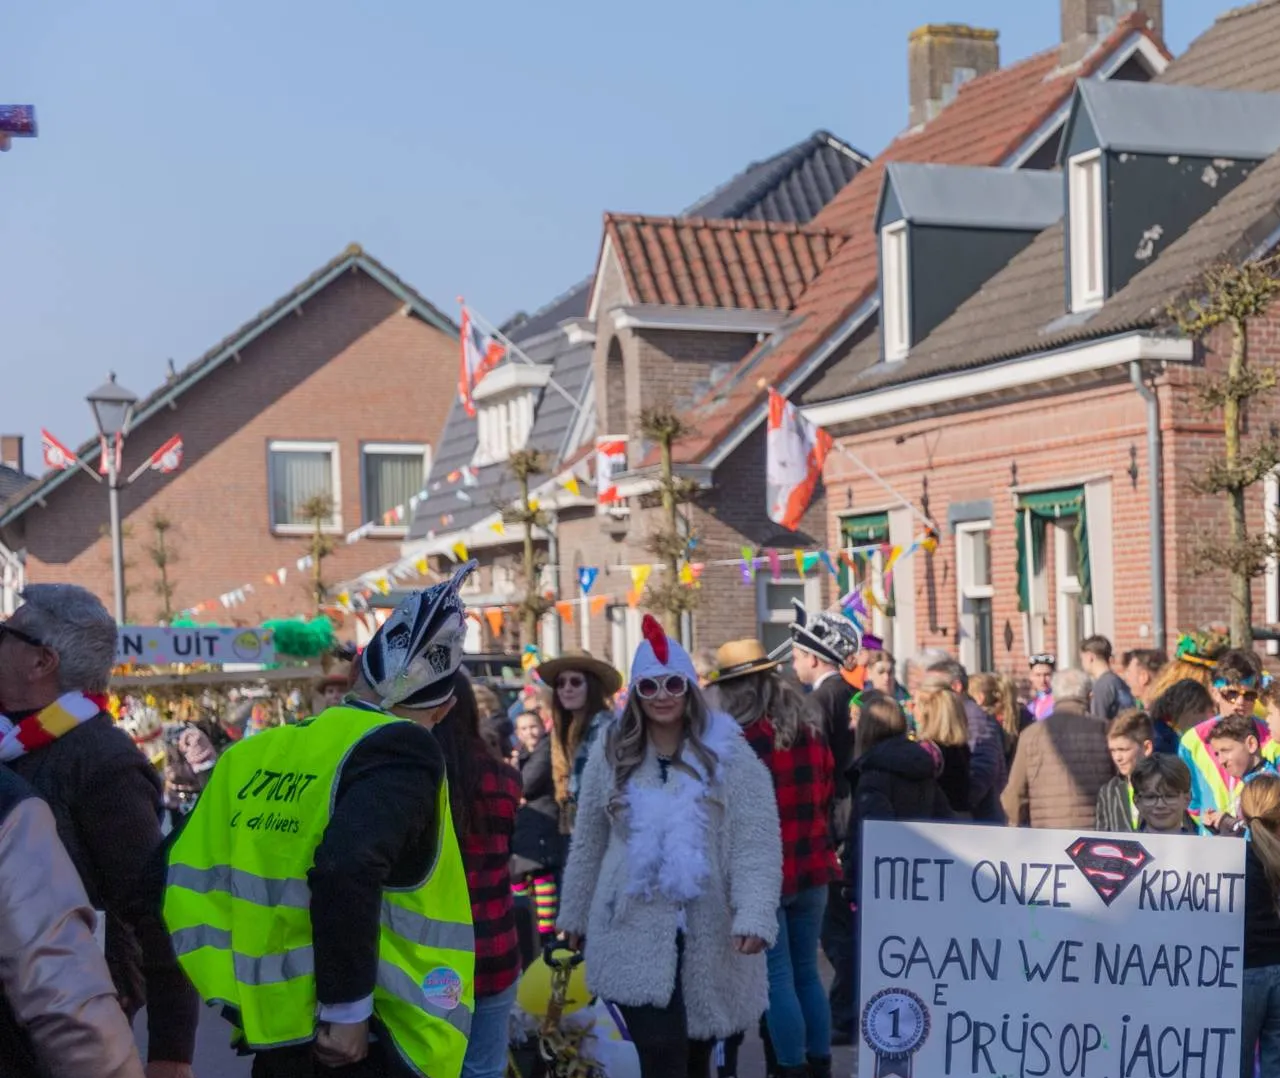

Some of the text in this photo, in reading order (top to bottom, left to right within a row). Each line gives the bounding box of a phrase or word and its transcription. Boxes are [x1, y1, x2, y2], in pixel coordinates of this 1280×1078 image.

[874, 856, 954, 902] MET
[972, 859, 1076, 908] ONZE
[1138, 869, 1245, 912] KRACHT
[878, 935, 1240, 988] GAAN WE NAAR DE
[888, 1007, 902, 1038] 1
[933, 983, 948, 1006] E
[1059, 1023, 1101, 1078] OP
